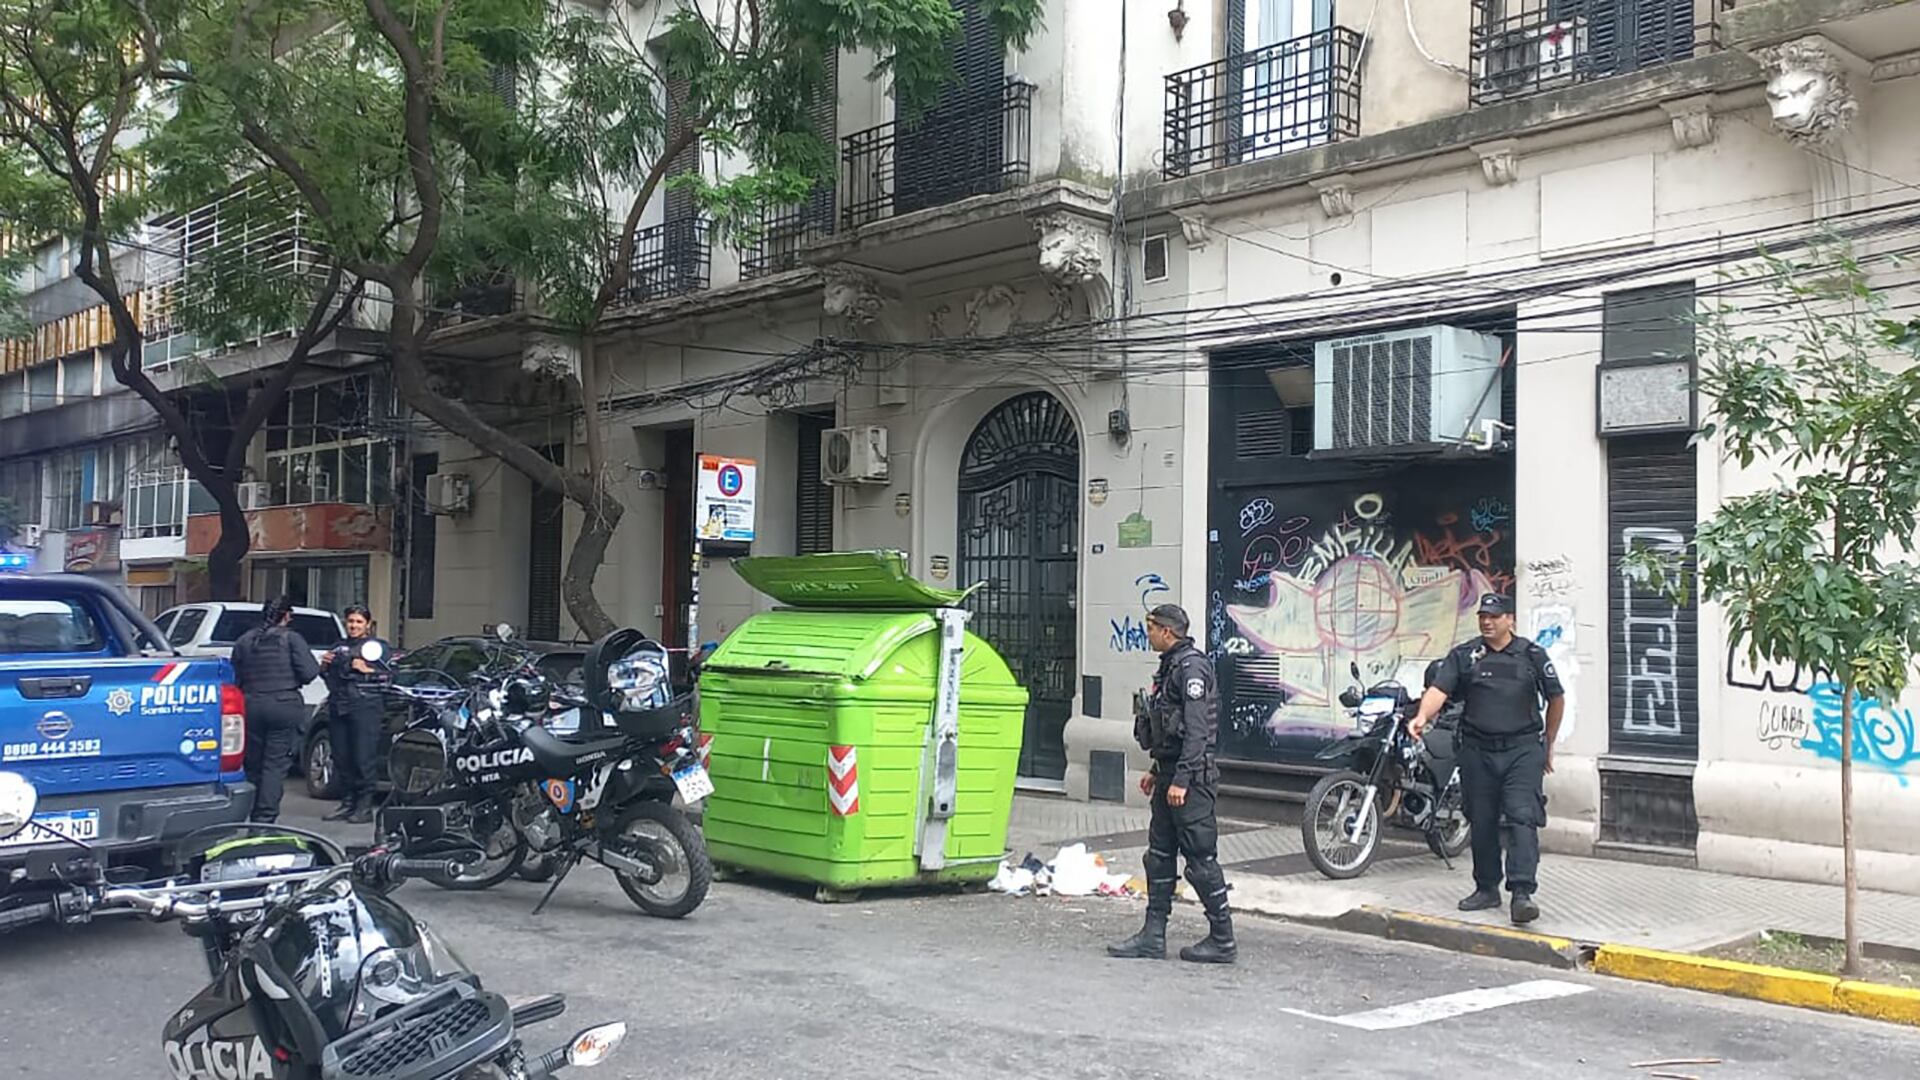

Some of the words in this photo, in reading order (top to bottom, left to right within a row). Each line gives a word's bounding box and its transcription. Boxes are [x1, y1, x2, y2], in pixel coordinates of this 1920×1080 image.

[725, 471, 736, 490] E
[140, 684, 217, 706] POLICIA
[3, 743, 37, 756] 0800
[40, 741, 66, 753] 444
[456, 747, 535, 772] POLICIA
[71, 819, 93, 837] ND
[164, 1035, 273, 1080] OLICIA
